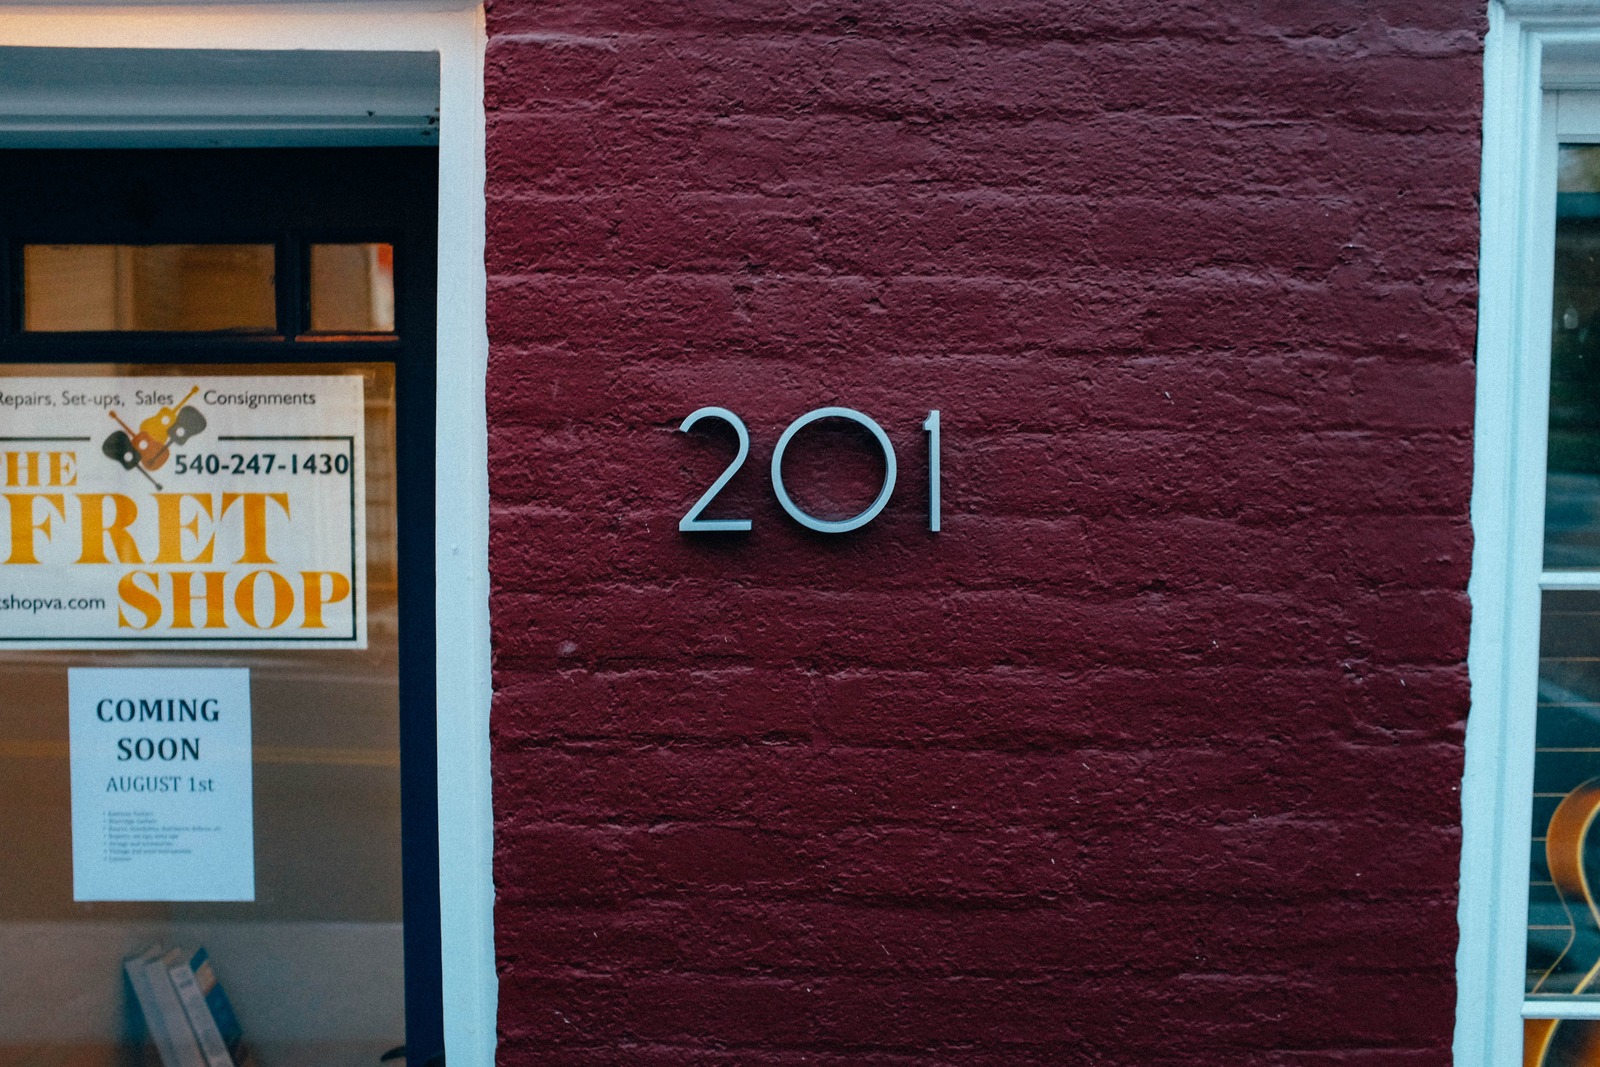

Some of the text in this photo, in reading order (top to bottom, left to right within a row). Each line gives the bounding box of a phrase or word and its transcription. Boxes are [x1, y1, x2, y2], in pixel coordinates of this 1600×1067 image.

[62, 391, 125, 410] Set-ups,
[135, 390, 174, 405] Sales
[203, 389, 316, 409] Consignments
[0, 451, 78, 487] HE
[174, 453, 349, 476] 540-247-1430
[679, 406, 941, 533] 201
[2, 492, 291, 564] FRET
[0, 594, 105, 614] shopva.com
[117, 569, 350, 630] SHOP
[96, 698, 220, 723] COMING
[117, 737, 201, 762] SOON
[106, 776, 215, 793] AUGUST 1st
